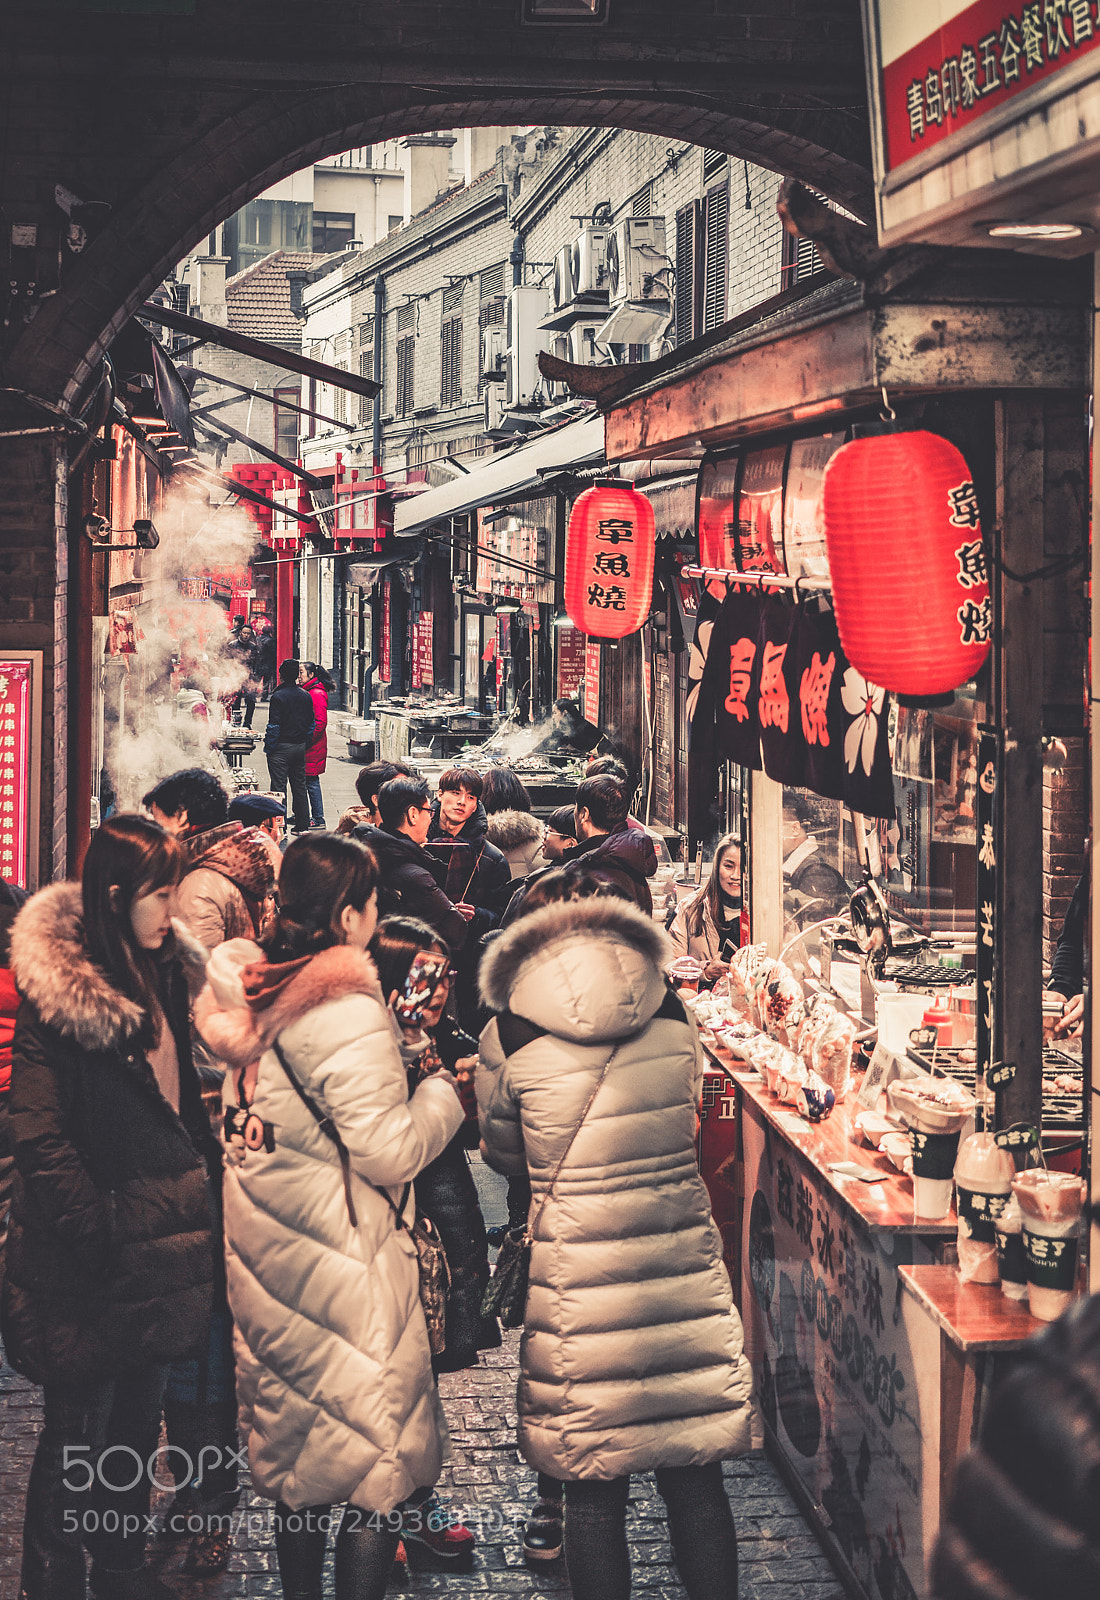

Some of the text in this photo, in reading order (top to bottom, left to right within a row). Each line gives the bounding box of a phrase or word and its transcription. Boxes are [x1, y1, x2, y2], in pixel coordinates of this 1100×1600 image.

[906, 0, 1100, 141] 青岛印象五谷餐饮管
